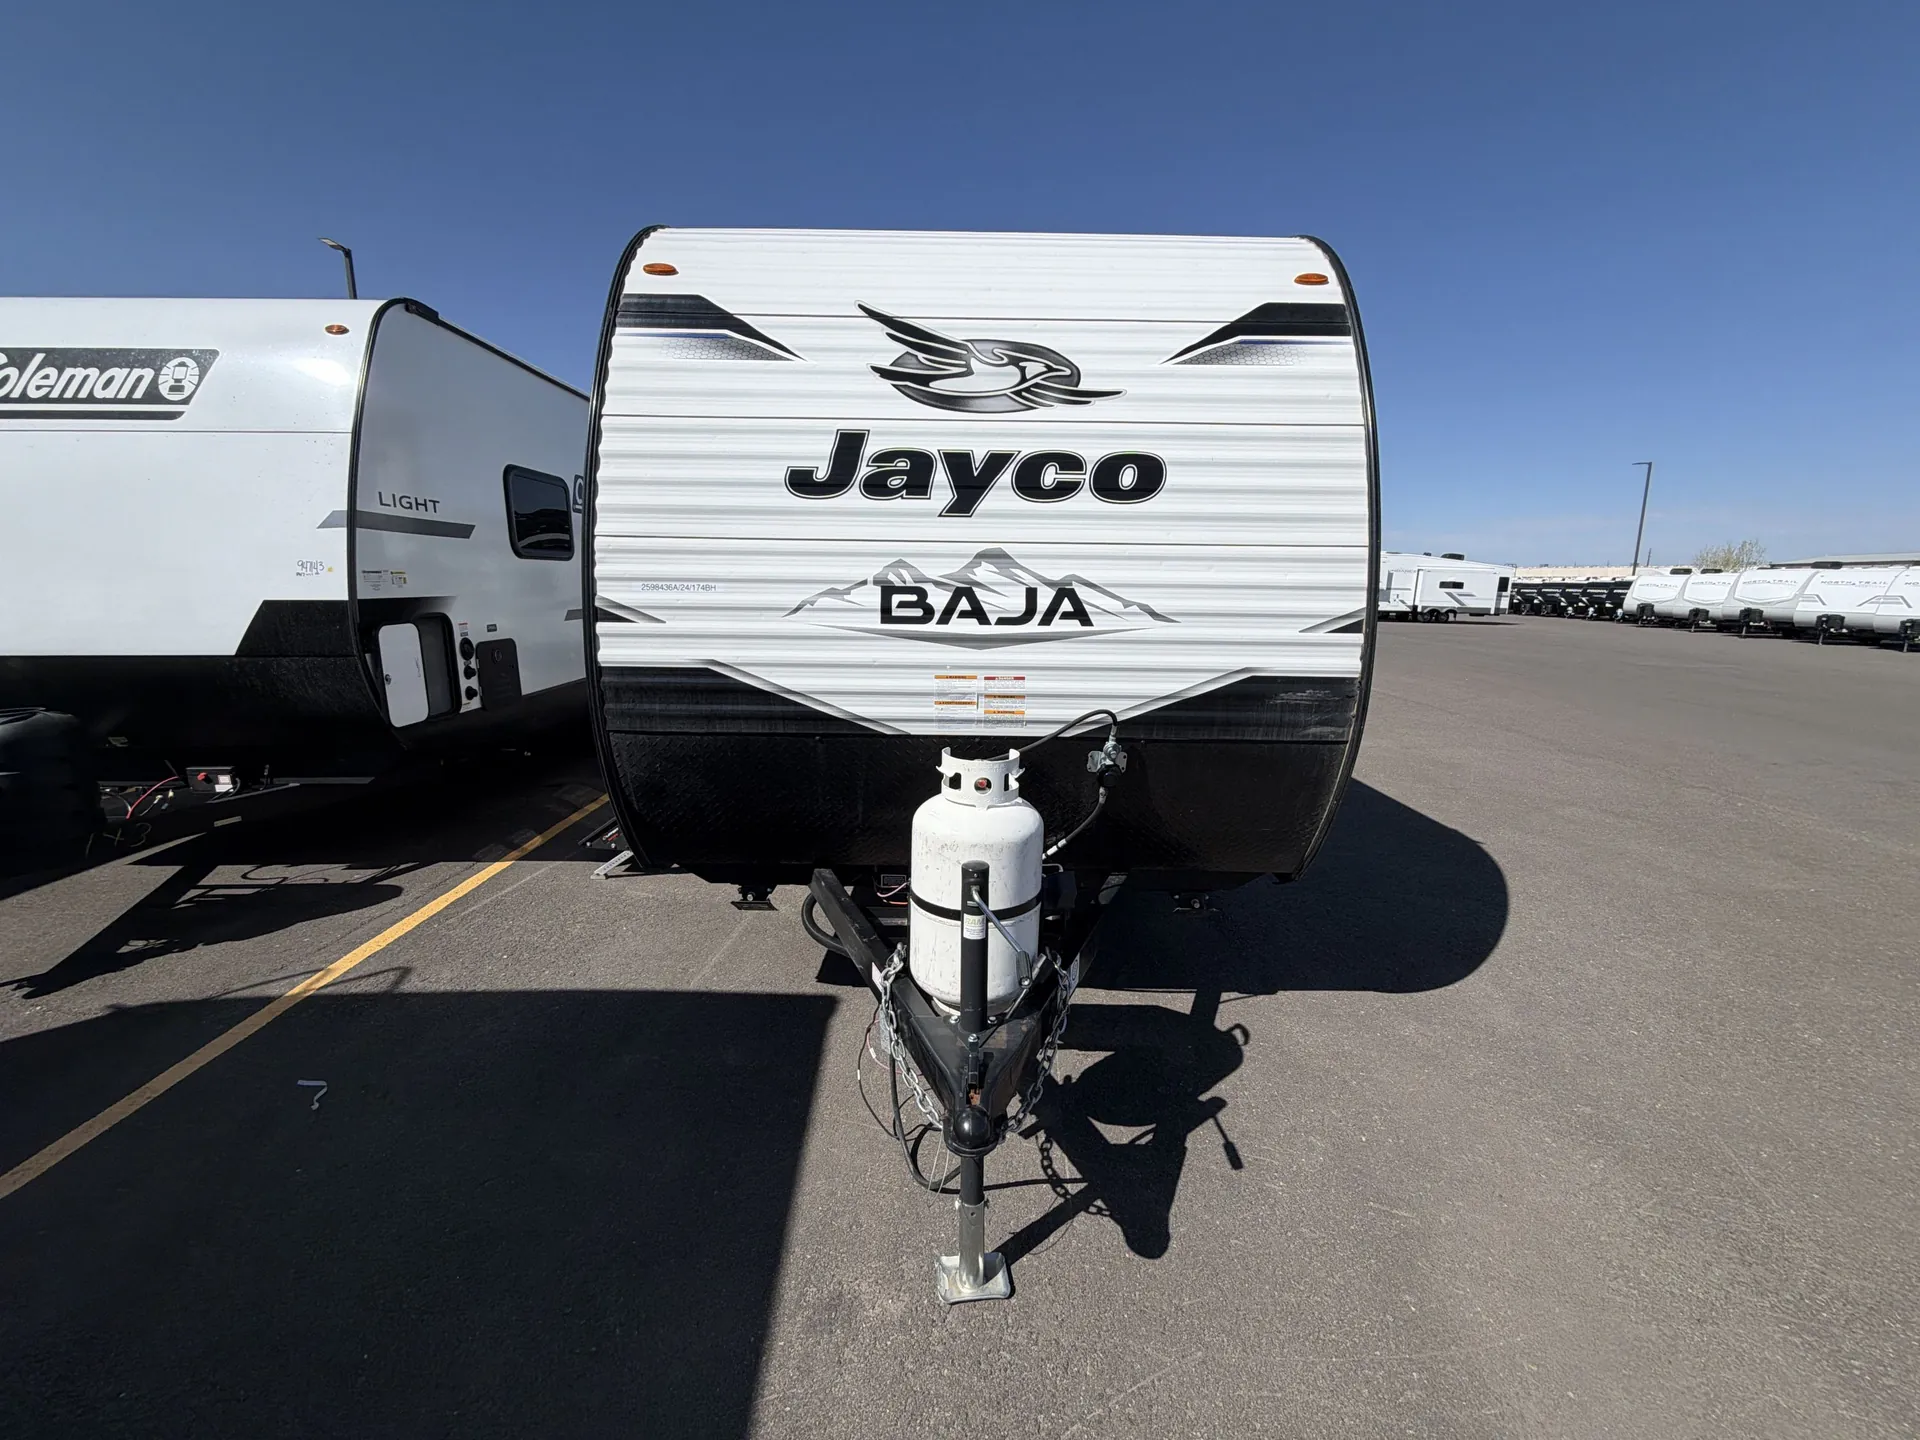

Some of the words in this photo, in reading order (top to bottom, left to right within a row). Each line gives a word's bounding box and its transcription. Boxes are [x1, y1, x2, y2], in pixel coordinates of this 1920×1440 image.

[783, 429, 1168, 518] Jayco
[378, 491, 440, 514] LIGHT
[641, 583, 717, 592] 2598436A/24/174BH
[880, 585, 1094, 627] BAJA
